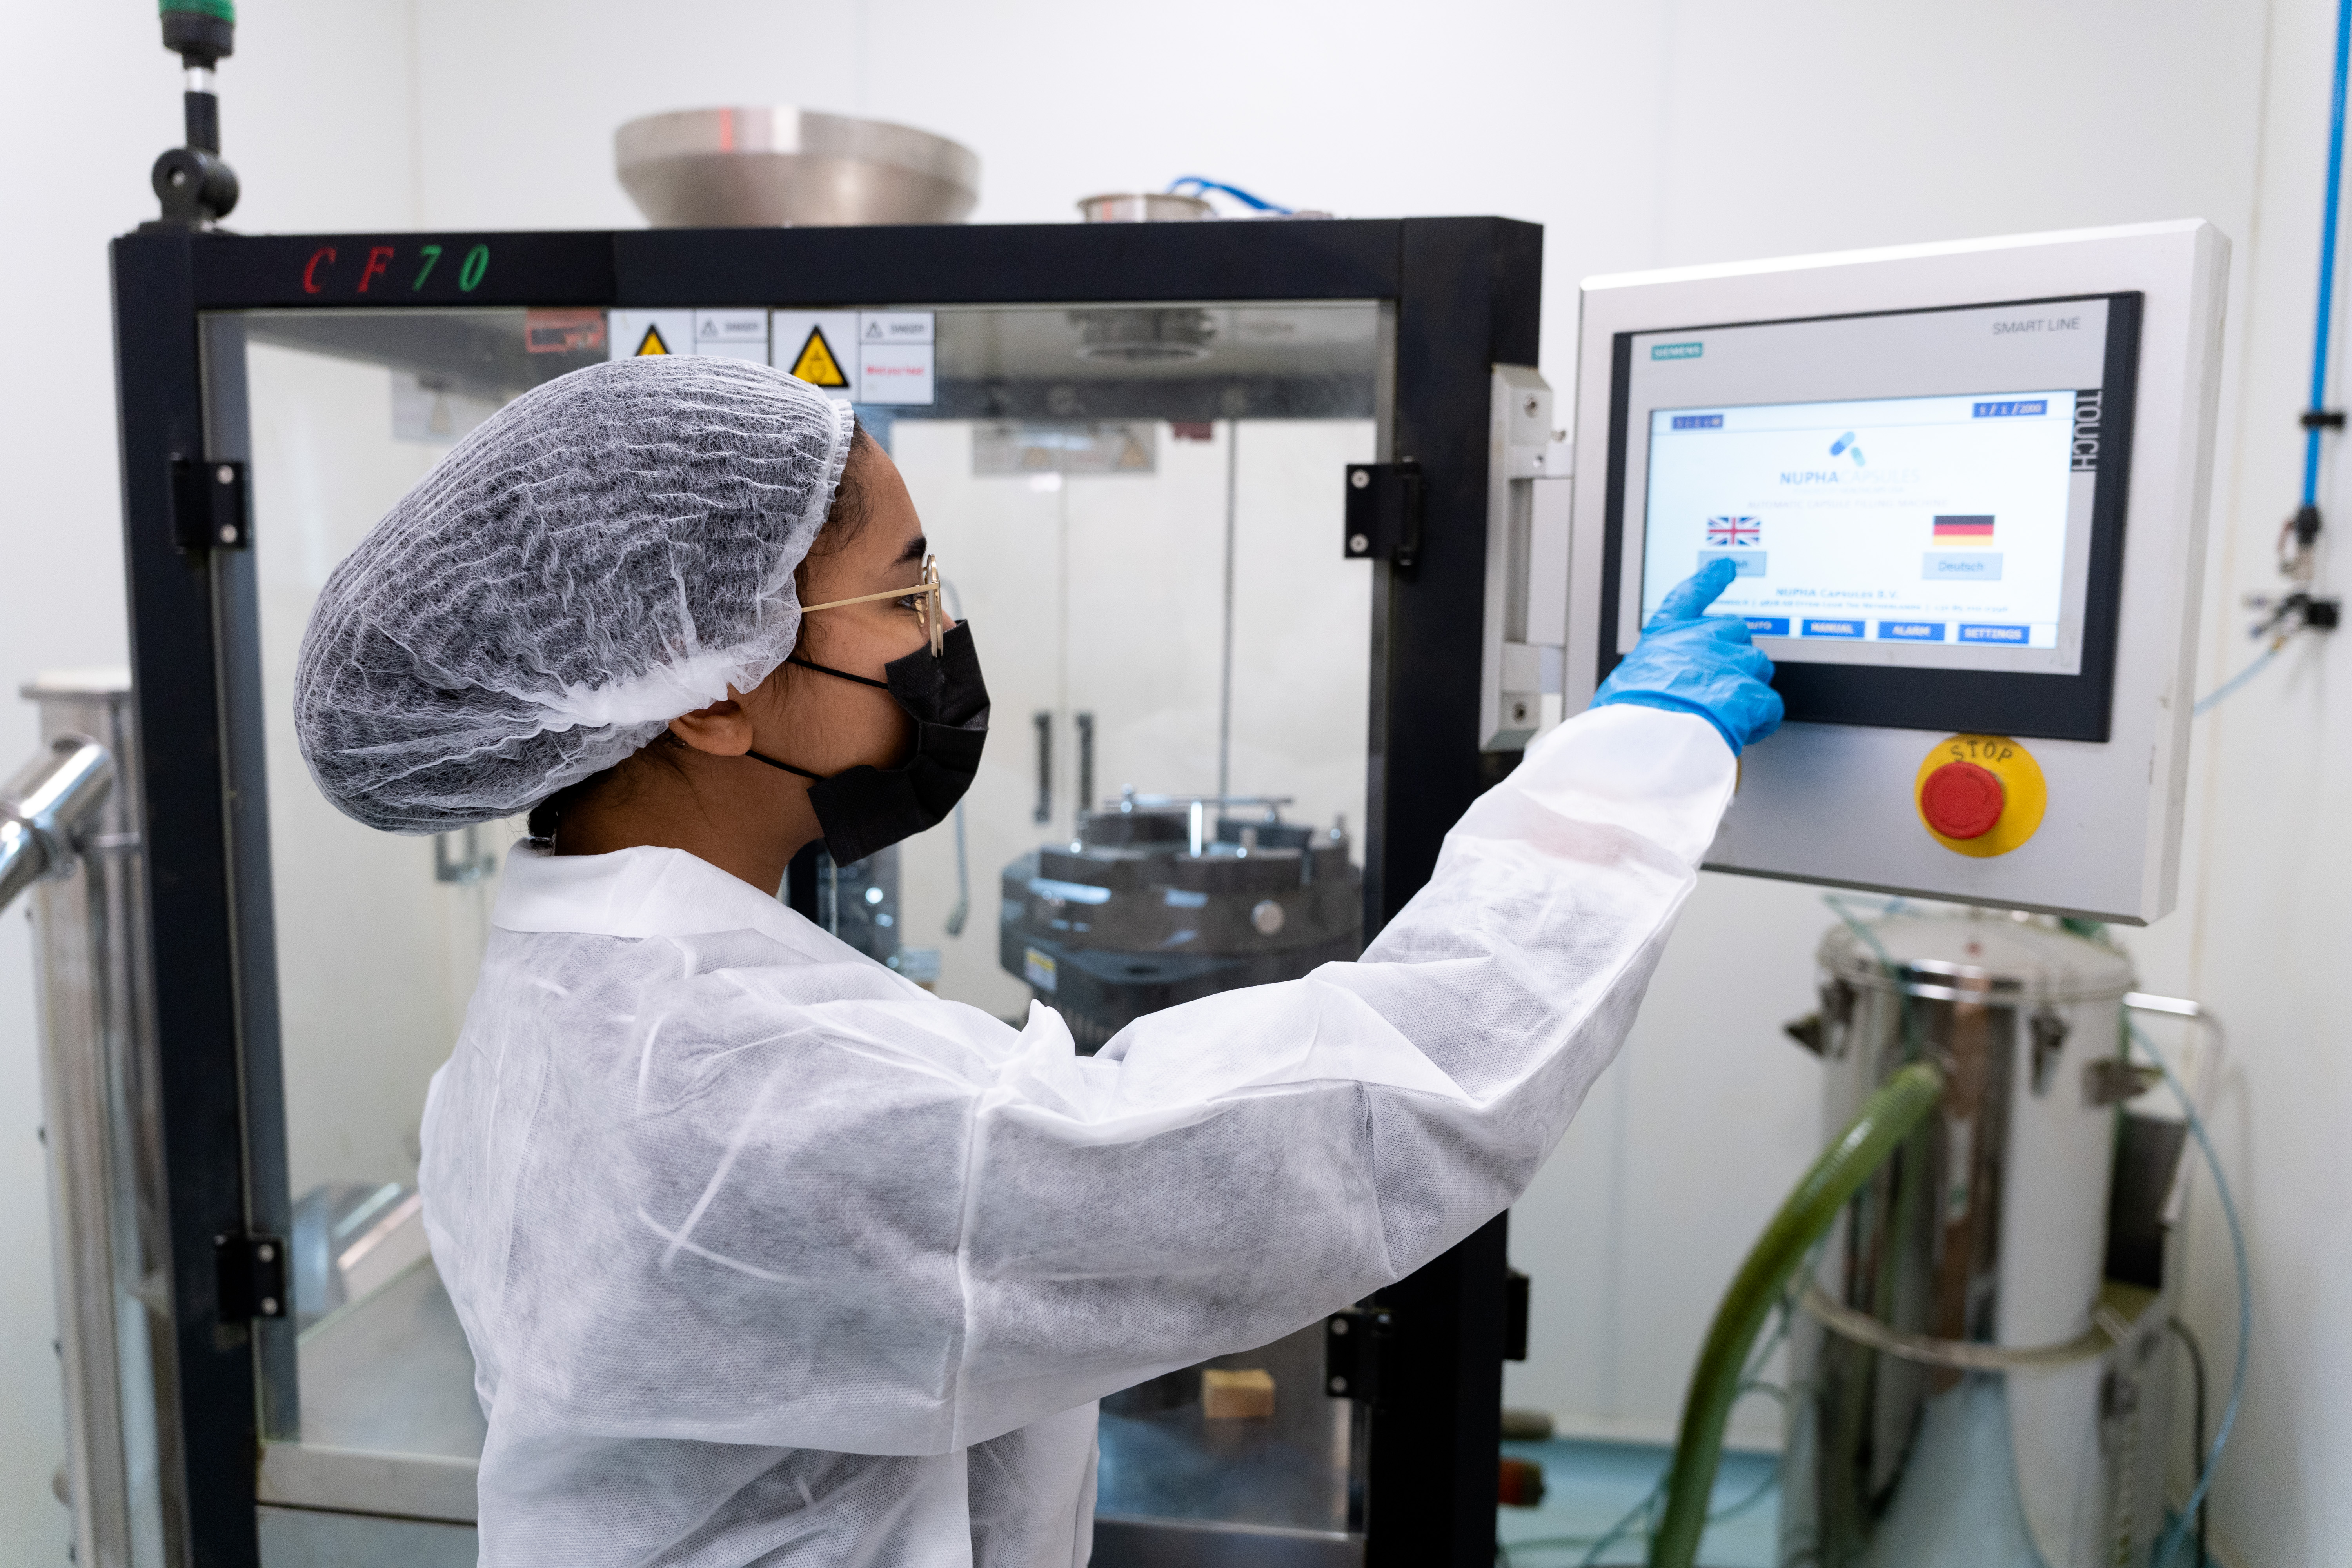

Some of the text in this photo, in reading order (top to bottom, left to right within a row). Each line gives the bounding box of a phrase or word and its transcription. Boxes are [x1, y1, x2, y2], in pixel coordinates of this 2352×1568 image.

[1993, 316, 2081, 335] SMART LINE
[1655, 346, 1700, 357] SIEMENS
[2070, 391, 2103, 471] TOUCH
[1938, 560, 1984, 572] Deutsch
[1776, 588, 1817, 597] NUPHA
[1746, 621, 1772, 630] AUTO
[1811, 622, 1854, 634] MANUAL
[1892, 625, 1931, 636] ALARM
[1964, 627, 2022, 640] SETTINGS
[1950, 739, 2013, 763] STOP
